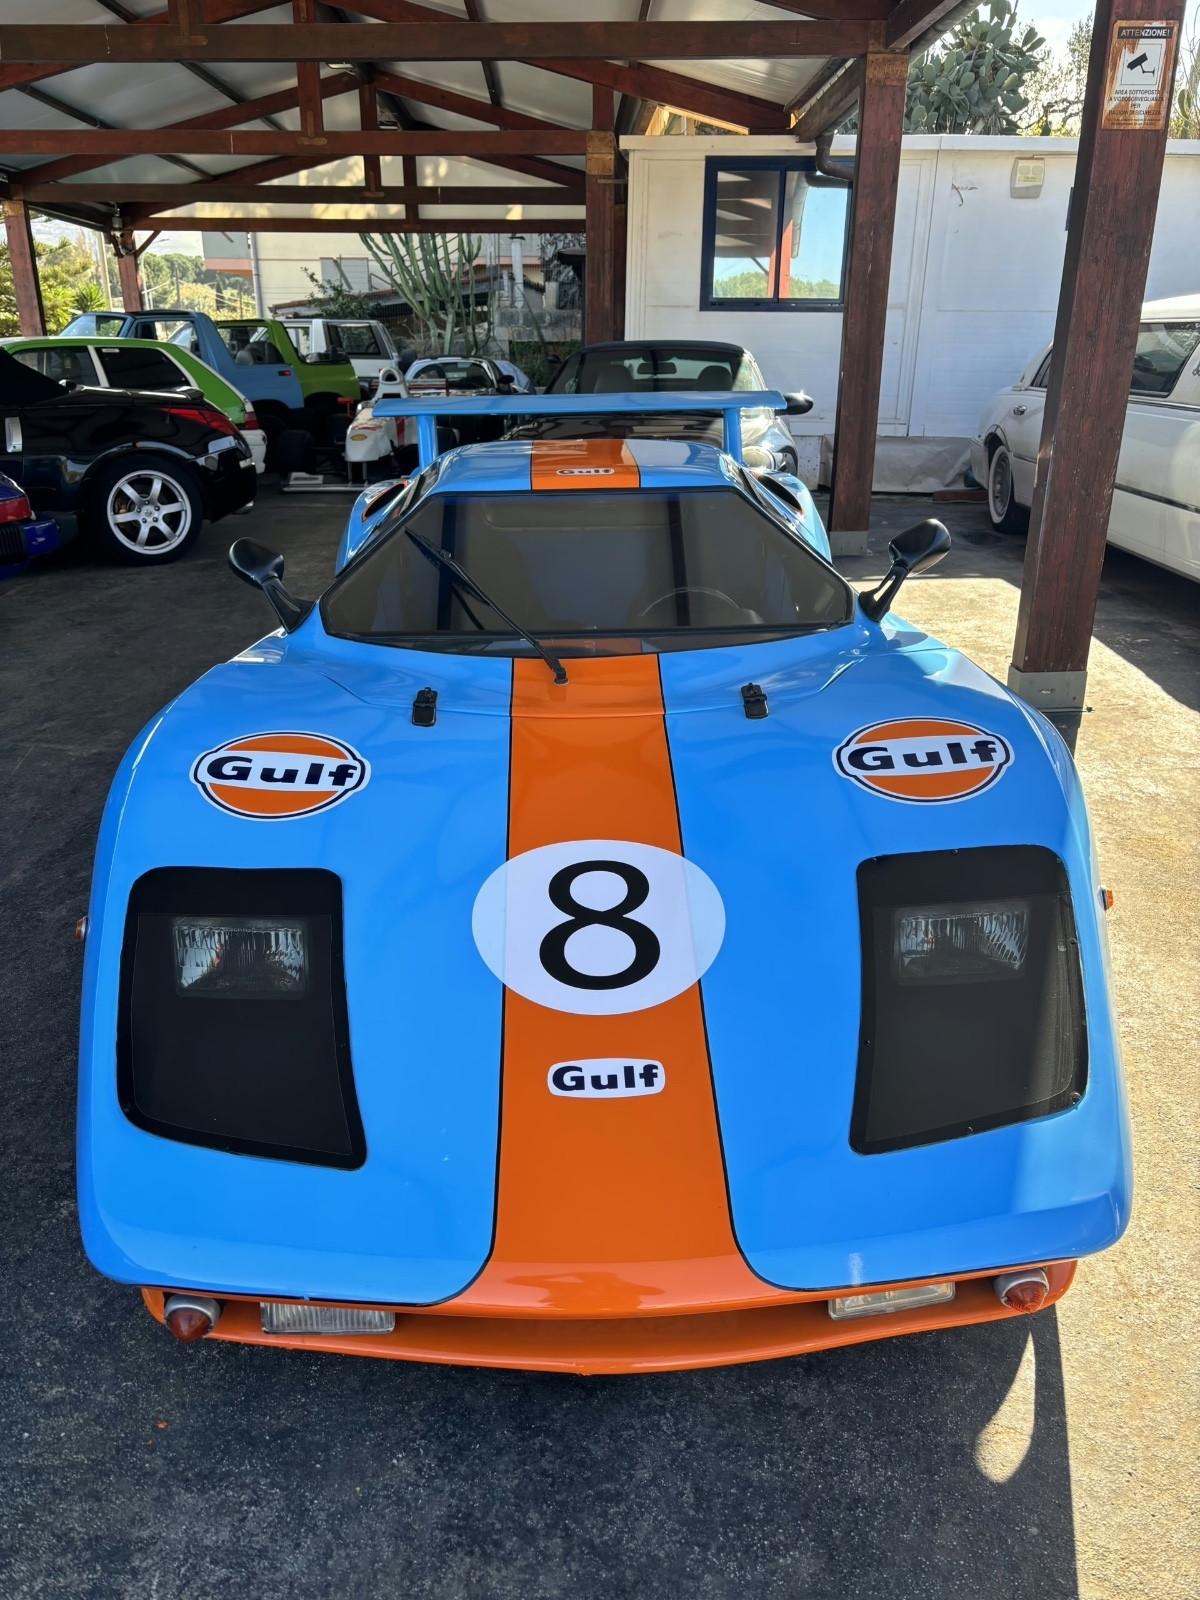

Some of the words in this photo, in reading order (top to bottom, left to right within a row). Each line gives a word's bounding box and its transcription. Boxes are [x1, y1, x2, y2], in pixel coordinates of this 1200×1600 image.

[1120, 28, 1170, 37] ATTENZIONE!
[206, 755, 358, 787] Gulf
[846, 740, 998, 771] Gulf
[539, 859, 661, 990] 8
[551, 1063, 660, 1092] Gulf
